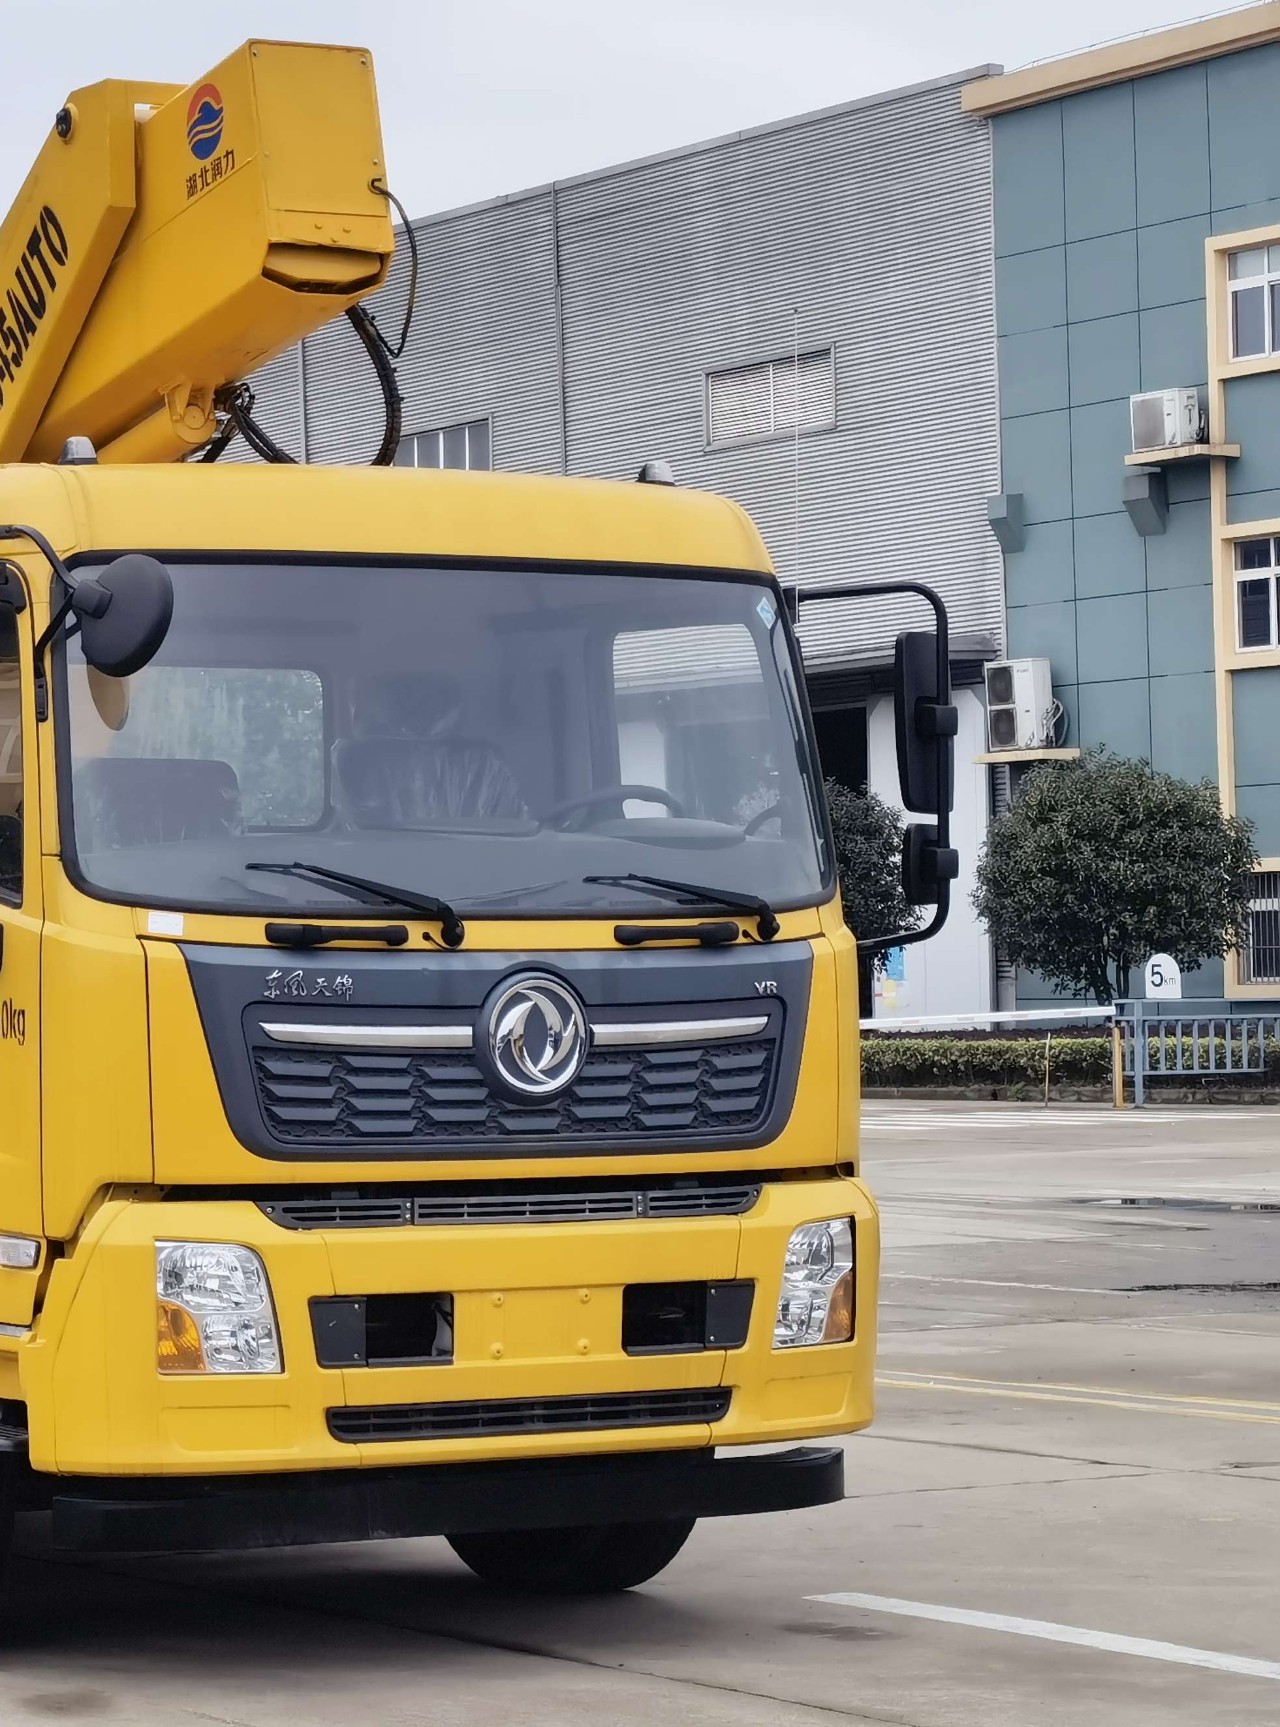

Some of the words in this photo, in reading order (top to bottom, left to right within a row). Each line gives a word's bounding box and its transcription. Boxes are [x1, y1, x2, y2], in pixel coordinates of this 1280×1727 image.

[186, 148, 236, 200] 湖北润力
[754, 981, 778, 995] VR
